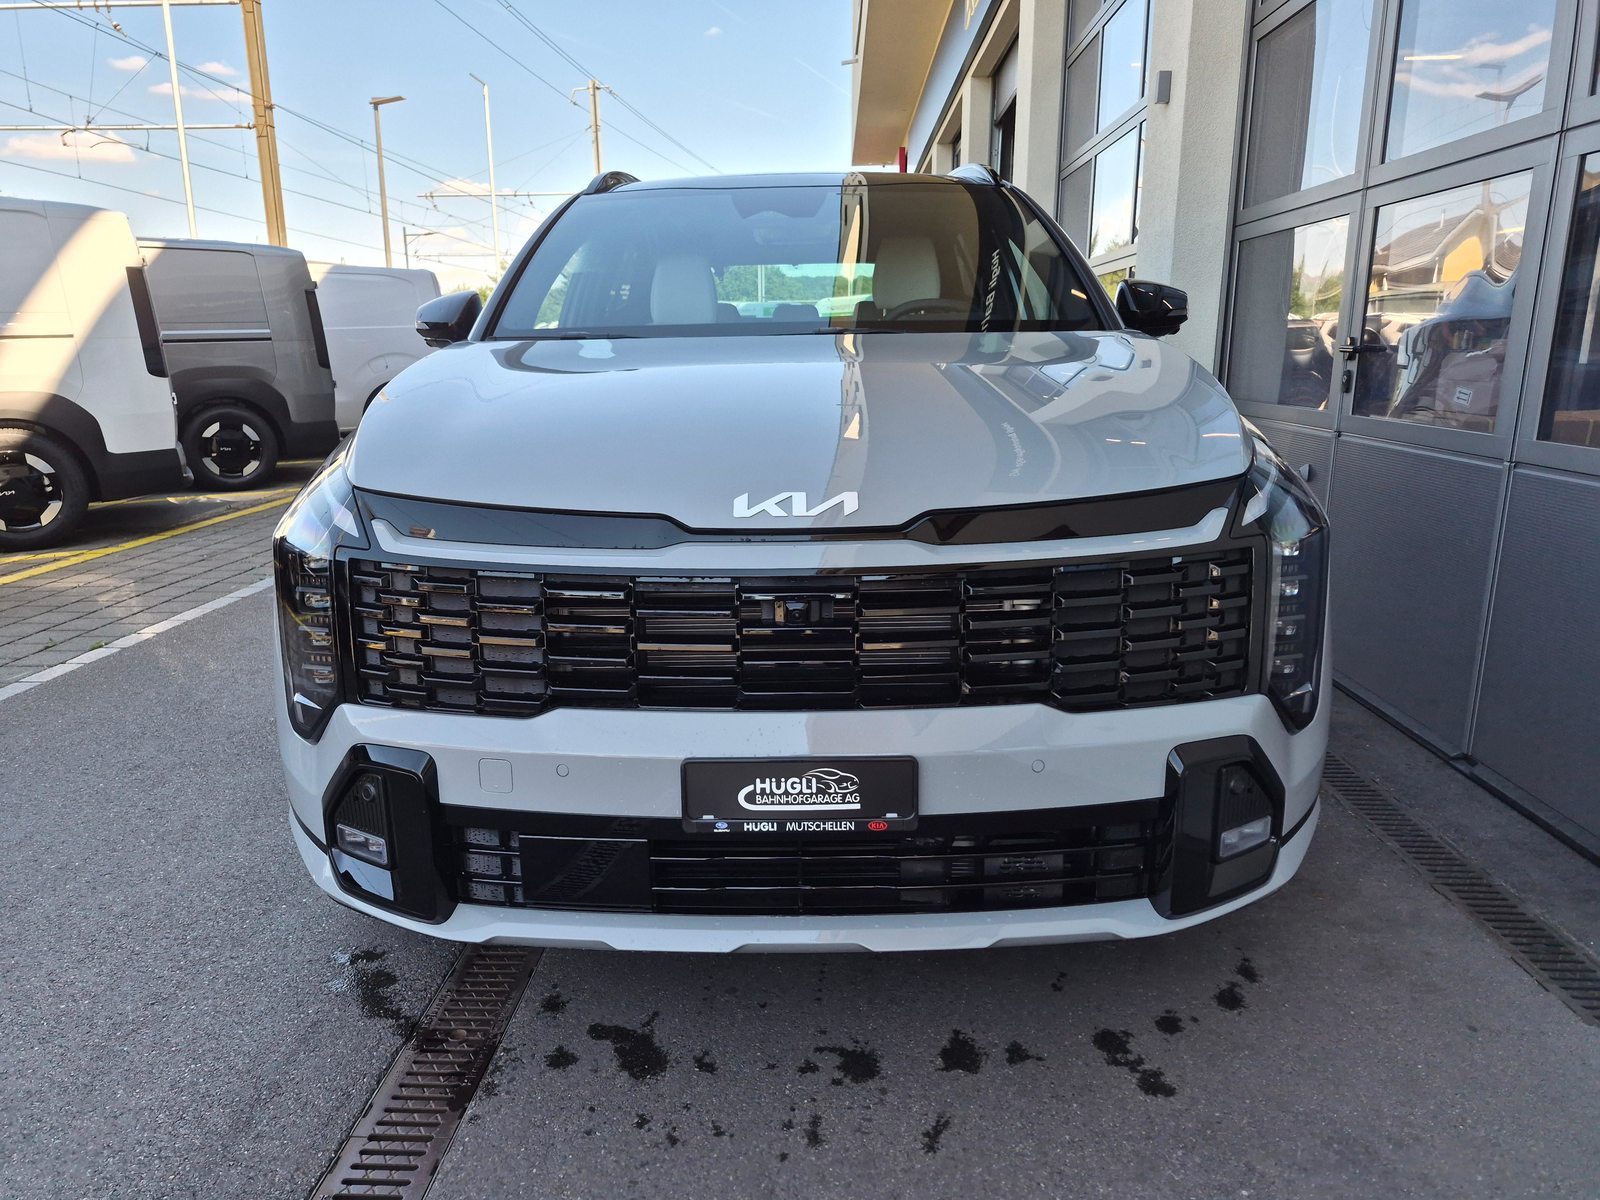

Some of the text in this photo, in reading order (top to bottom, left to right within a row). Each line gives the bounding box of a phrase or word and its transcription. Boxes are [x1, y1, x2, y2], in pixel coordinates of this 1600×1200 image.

[733, 491, 859, 518] KIA
[755, 777, 817, 794] HÜGLI
[755, 793, 860, 804] BAHNHOFGARAGE AG
[785, 821, 855, 831] MUTSCHELLEN
[870, 822, 885, 830] KIA
